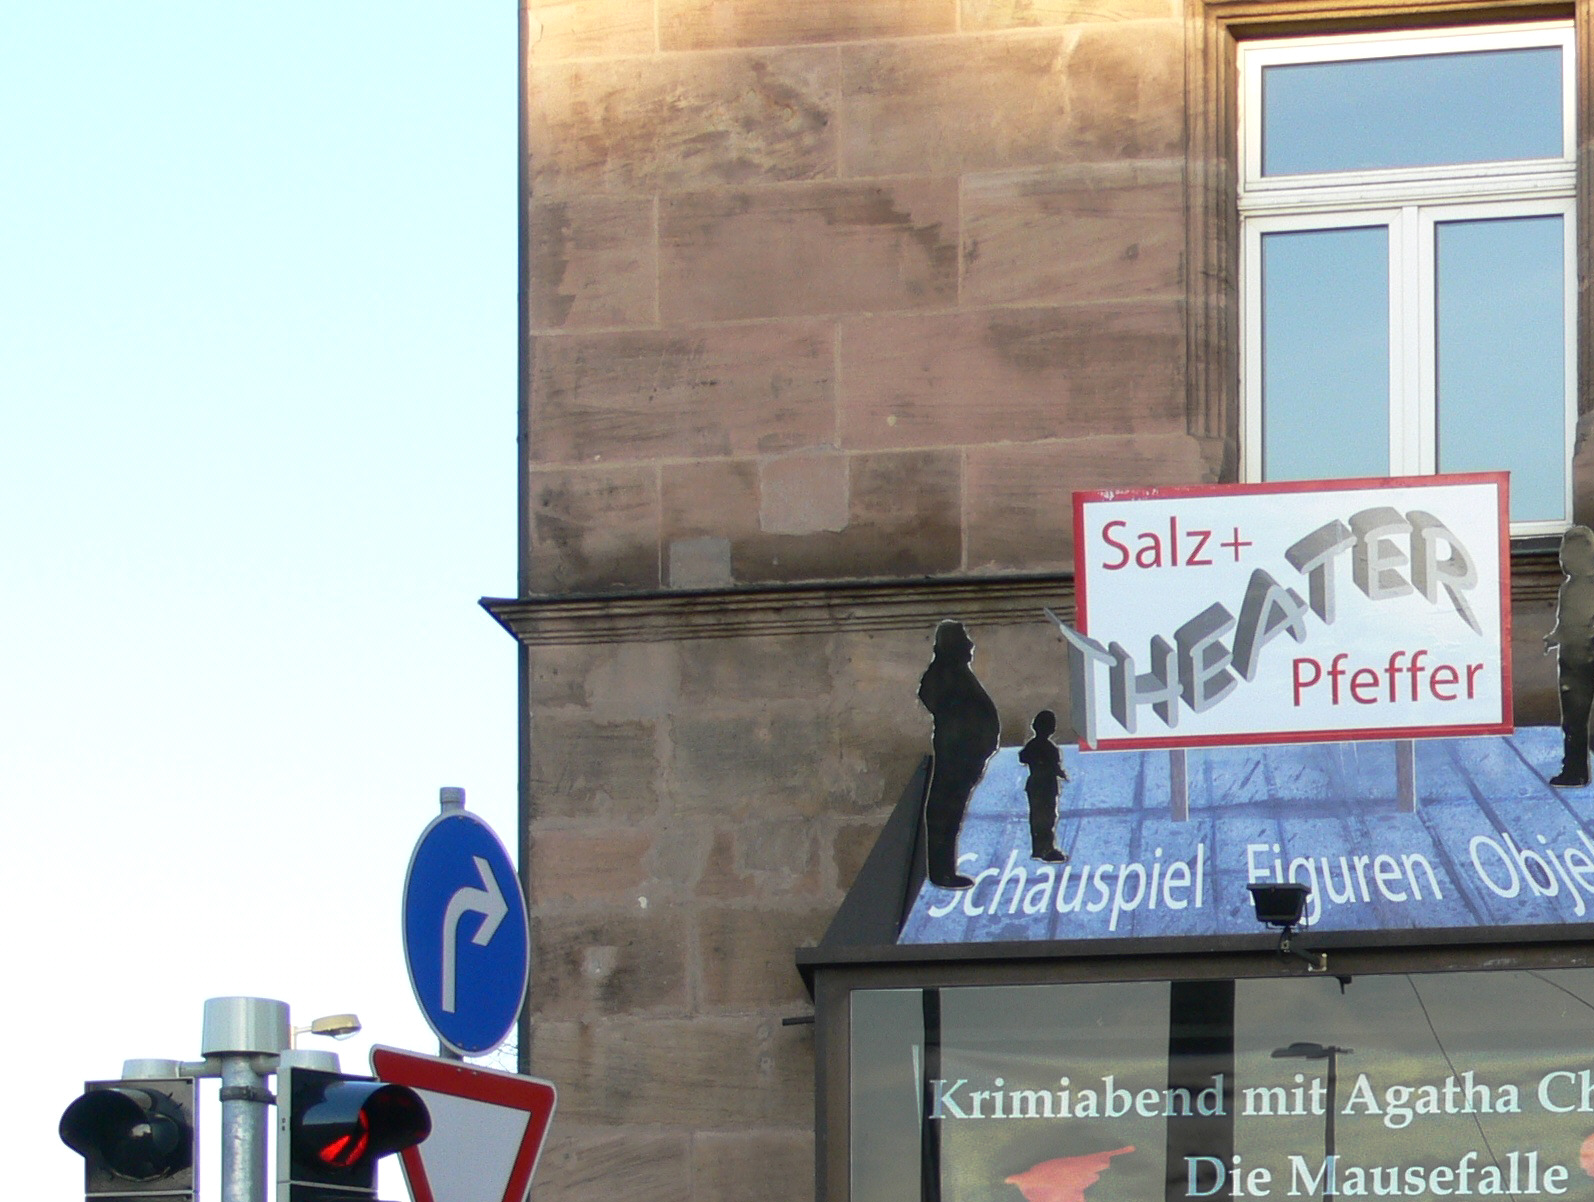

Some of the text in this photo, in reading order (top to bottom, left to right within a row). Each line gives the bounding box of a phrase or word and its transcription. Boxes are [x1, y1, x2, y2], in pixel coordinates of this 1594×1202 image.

[1102, 515, 1253, 571] Salz+
[1043, 506, 1483, 750] THEATER
[1292, 650, 1485, 707] Pfeffer
[927, 843, 1204, 931] Schauspiel
[1246, 843, 1443, 926] Figuren
[929, 1073, 1228, 1120] Krimiabend
[1241, 1073, 1328, 1117] mit
[1341, 1070, 1521, 1129] Agatha
[1184, 1151, 1569, 1198] Die Mausefalle
